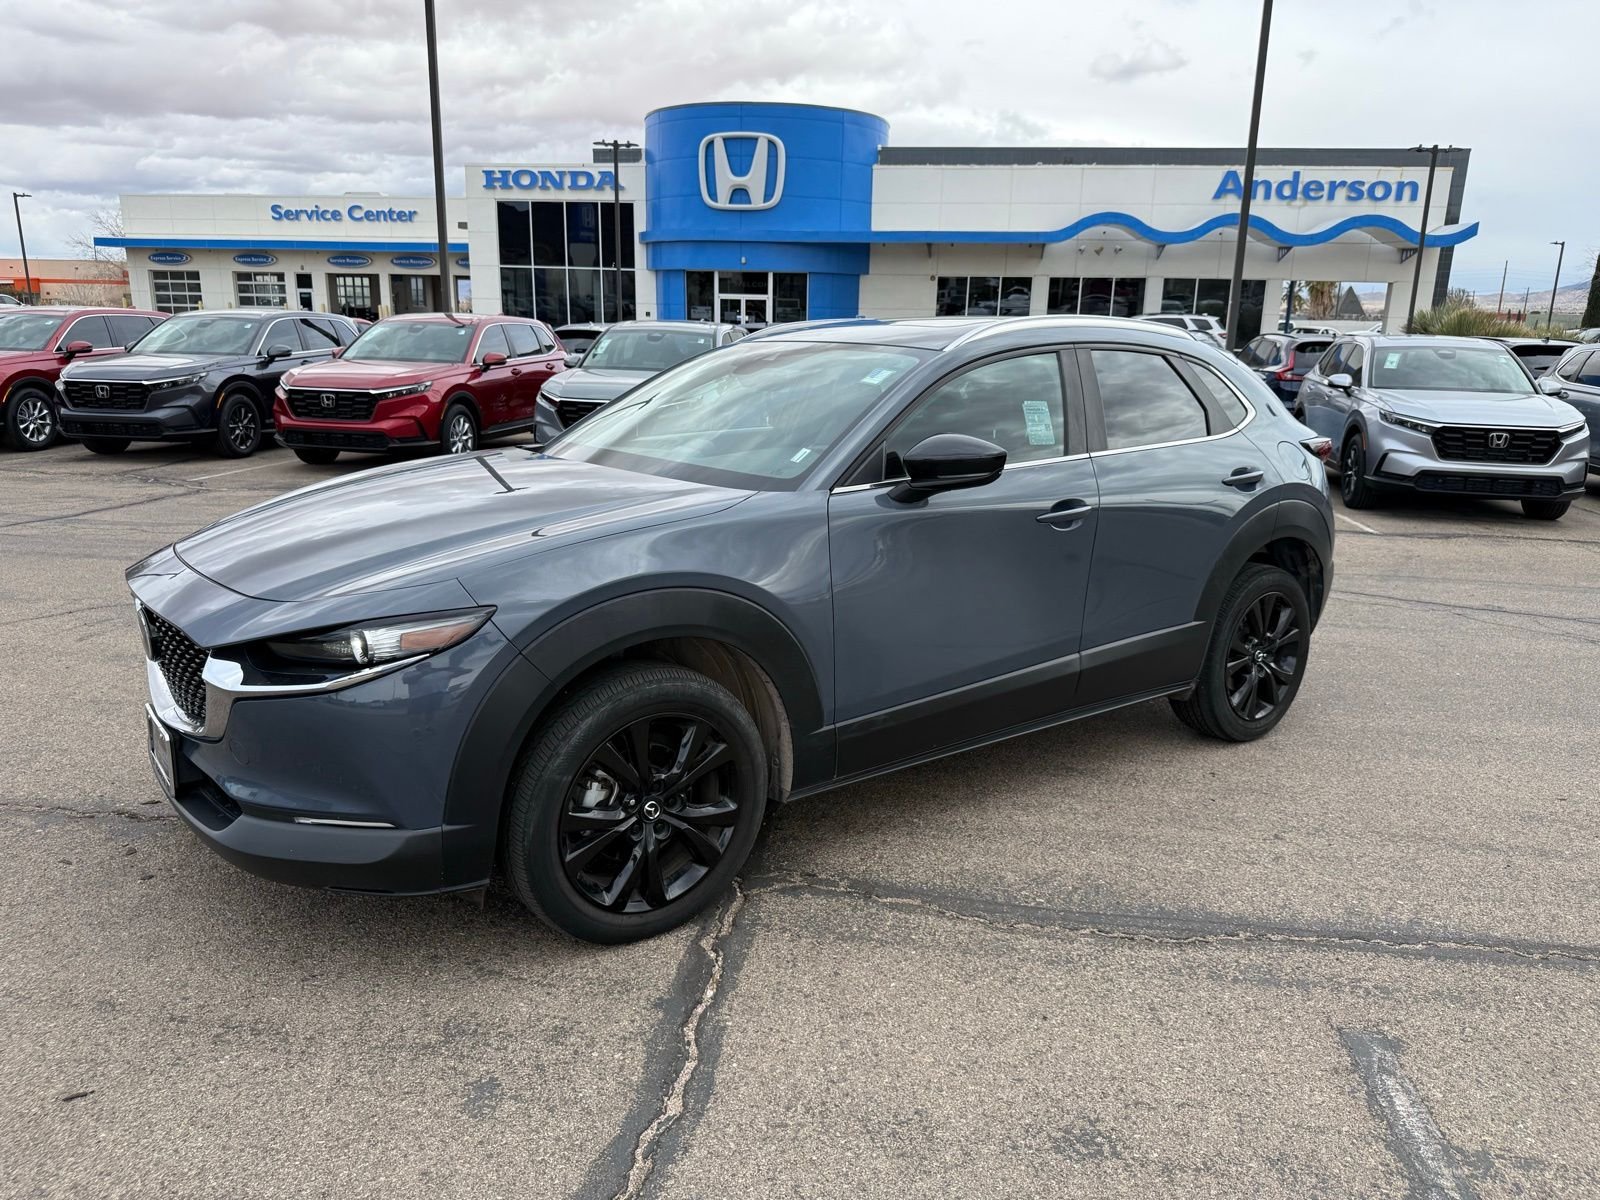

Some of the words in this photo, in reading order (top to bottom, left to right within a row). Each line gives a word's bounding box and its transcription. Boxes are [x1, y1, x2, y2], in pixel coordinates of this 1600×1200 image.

[482, 169, 625, 191] HONDA
[1212, 170, 1420, 202] Anderson
[270, 204, 342, 221] Service
[347, 204, 418, 222] Center
